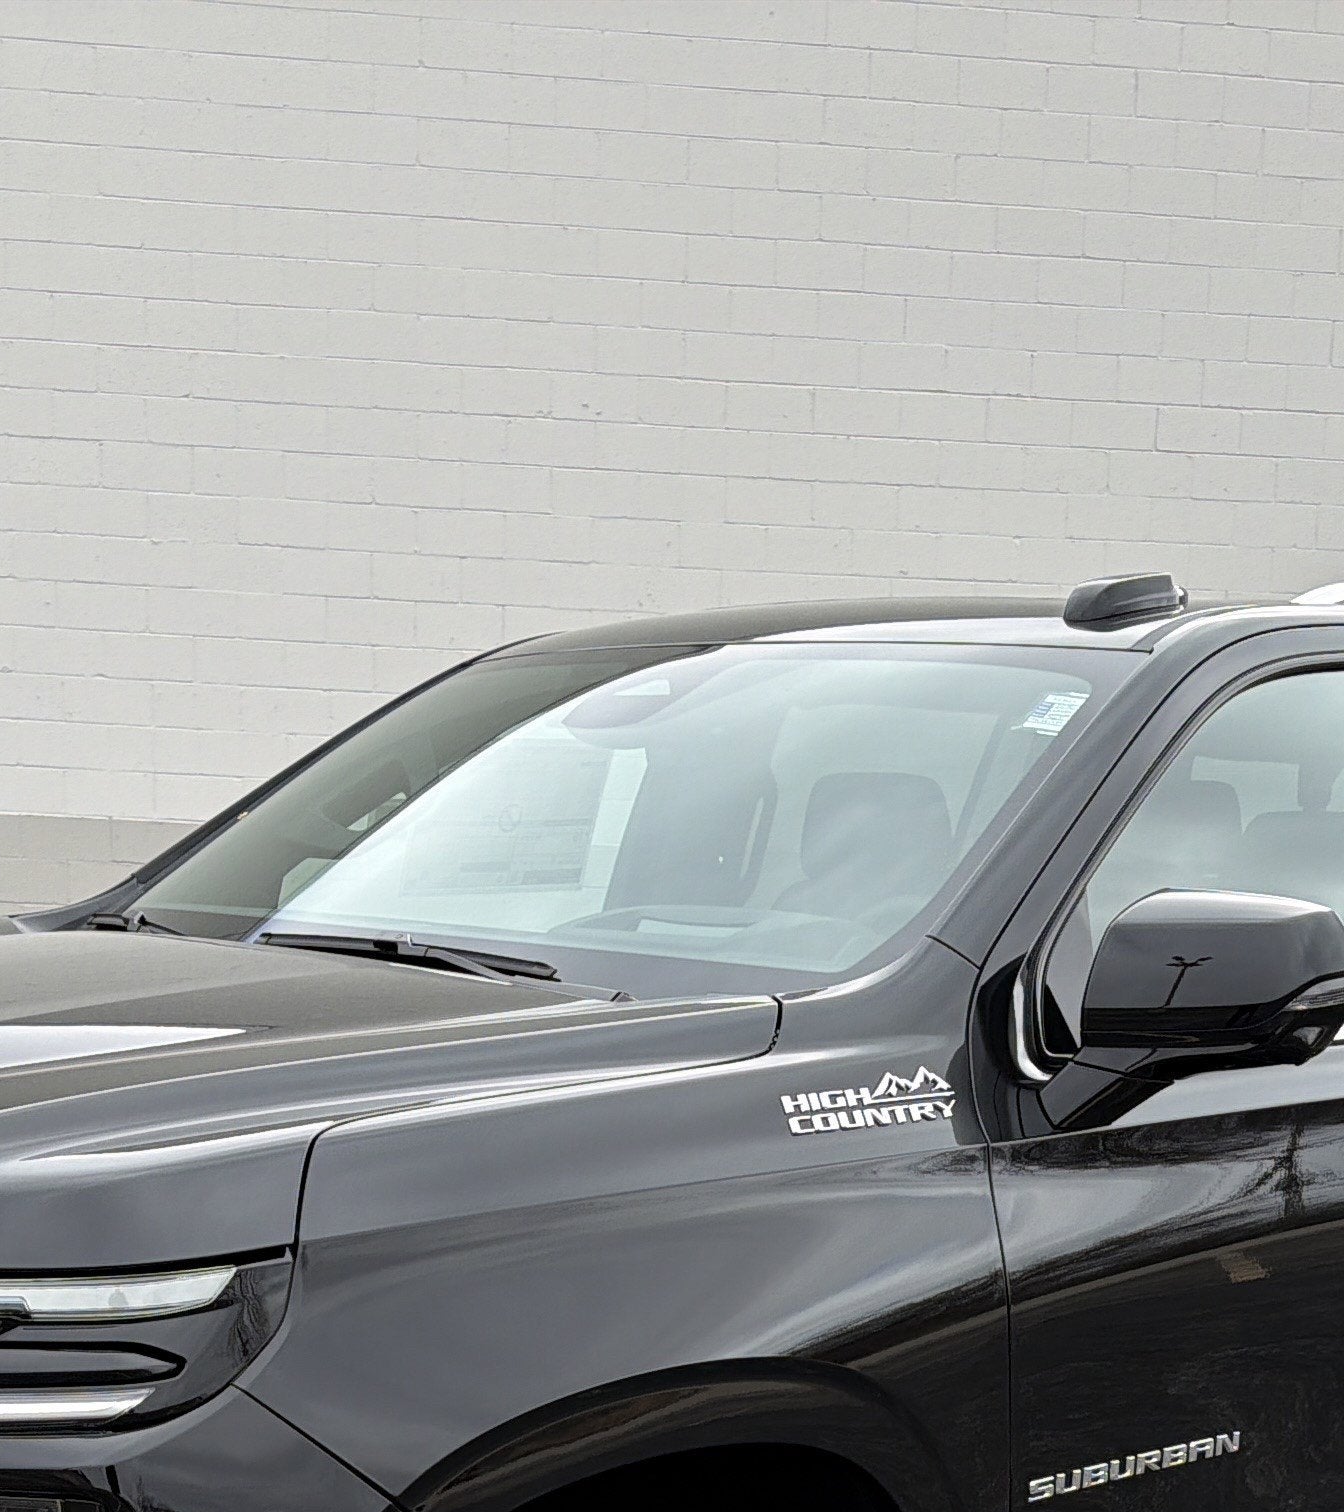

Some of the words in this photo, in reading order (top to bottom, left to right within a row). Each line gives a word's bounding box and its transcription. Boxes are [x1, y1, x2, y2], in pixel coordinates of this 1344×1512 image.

[781, 1086, 875, 1114] HIGH
[788, 1099, 956, 1134] COUNTRY
[1027, 1430, 1241, 1503] SUBURBAN
